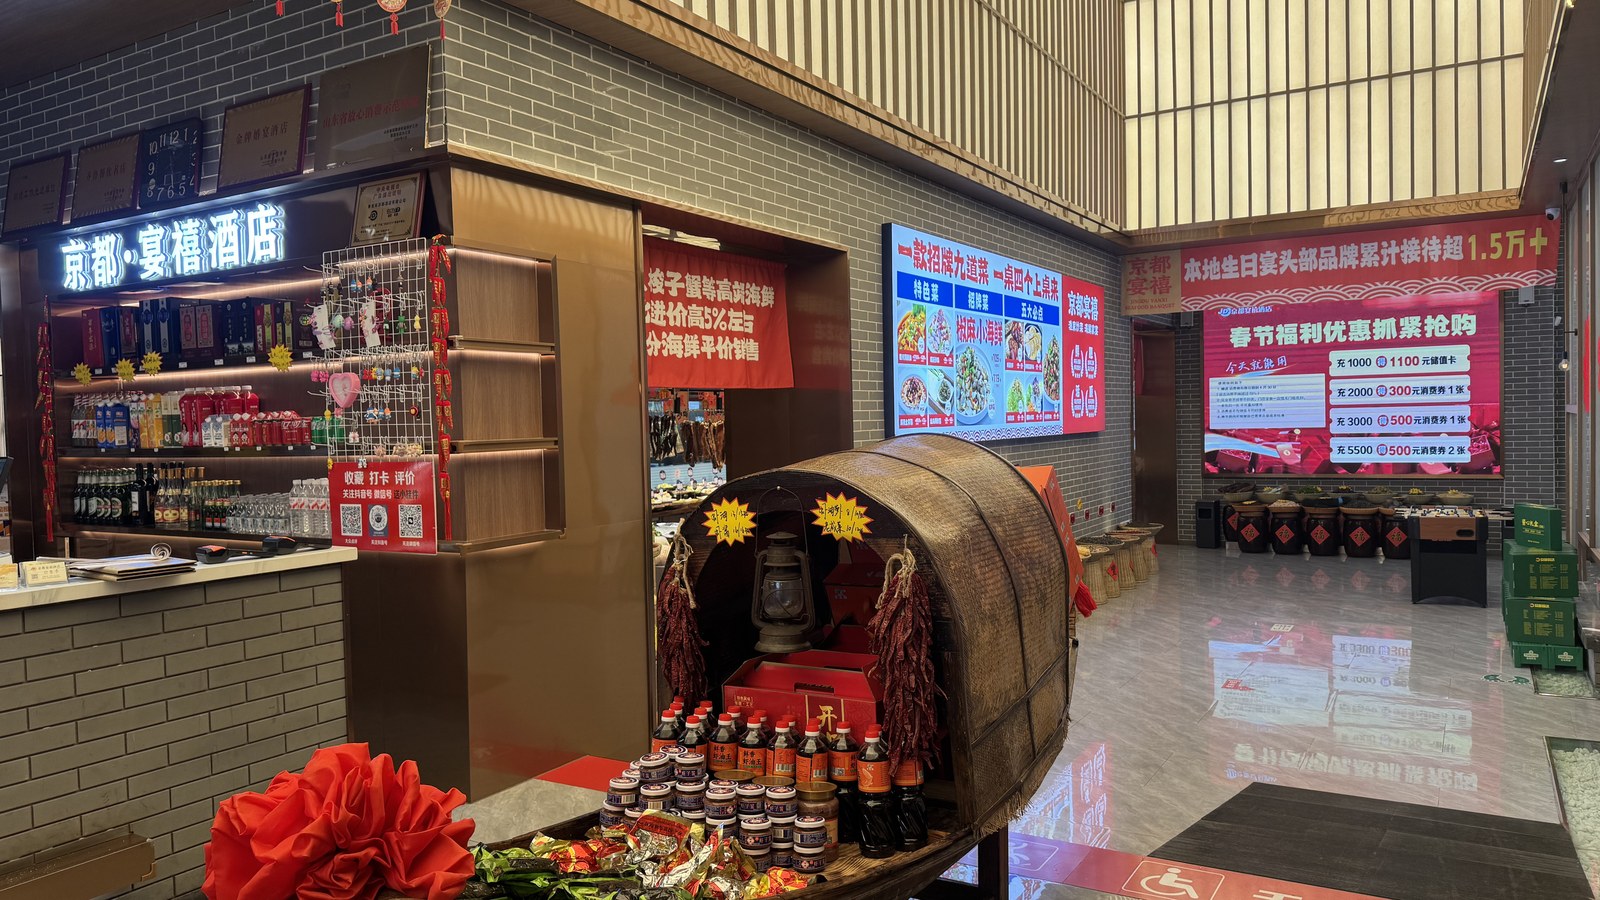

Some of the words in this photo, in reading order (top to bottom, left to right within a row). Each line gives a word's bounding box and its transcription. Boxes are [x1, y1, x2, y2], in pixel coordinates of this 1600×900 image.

[323, 96, 419, 129] 山东省放心消费示范
[160, 133, 167, 147] 11
[169, 130, 179, 145] 12
[149, 141, 158, 155] 10
[148, 162, 155, 176] 9
[157, 187, 165, 201] 7
[167, 185, 175, 199] 6
[179, 182, 186, 196] 5
[61, 204, 286, 291] 京都·宴禧酒店
[898, 237, 989, 286] 一款招牌九道菜
[1127, 256, 1171, 275] 京都
[914, 279, 939, 302] 特色菜
[1126, 275, 1172, 295] 宴禧
[968, 291, 989, 311] 招牌菜
[1067, 290, 1099, 321] 京都宴禧
[1021, 302, 1044, 321] 五大必点
[1230, 313, 1477, 348] 春节福利优惠抓紧抢购
[1226, 356, 1287, 374] 今天就能用
[344, 470, 364, 485] 收藏
[369, 471, 389, 485] 打卡
[395, 470, 415, 485] 评价
[743, 758, 761, 766] 虾油王
